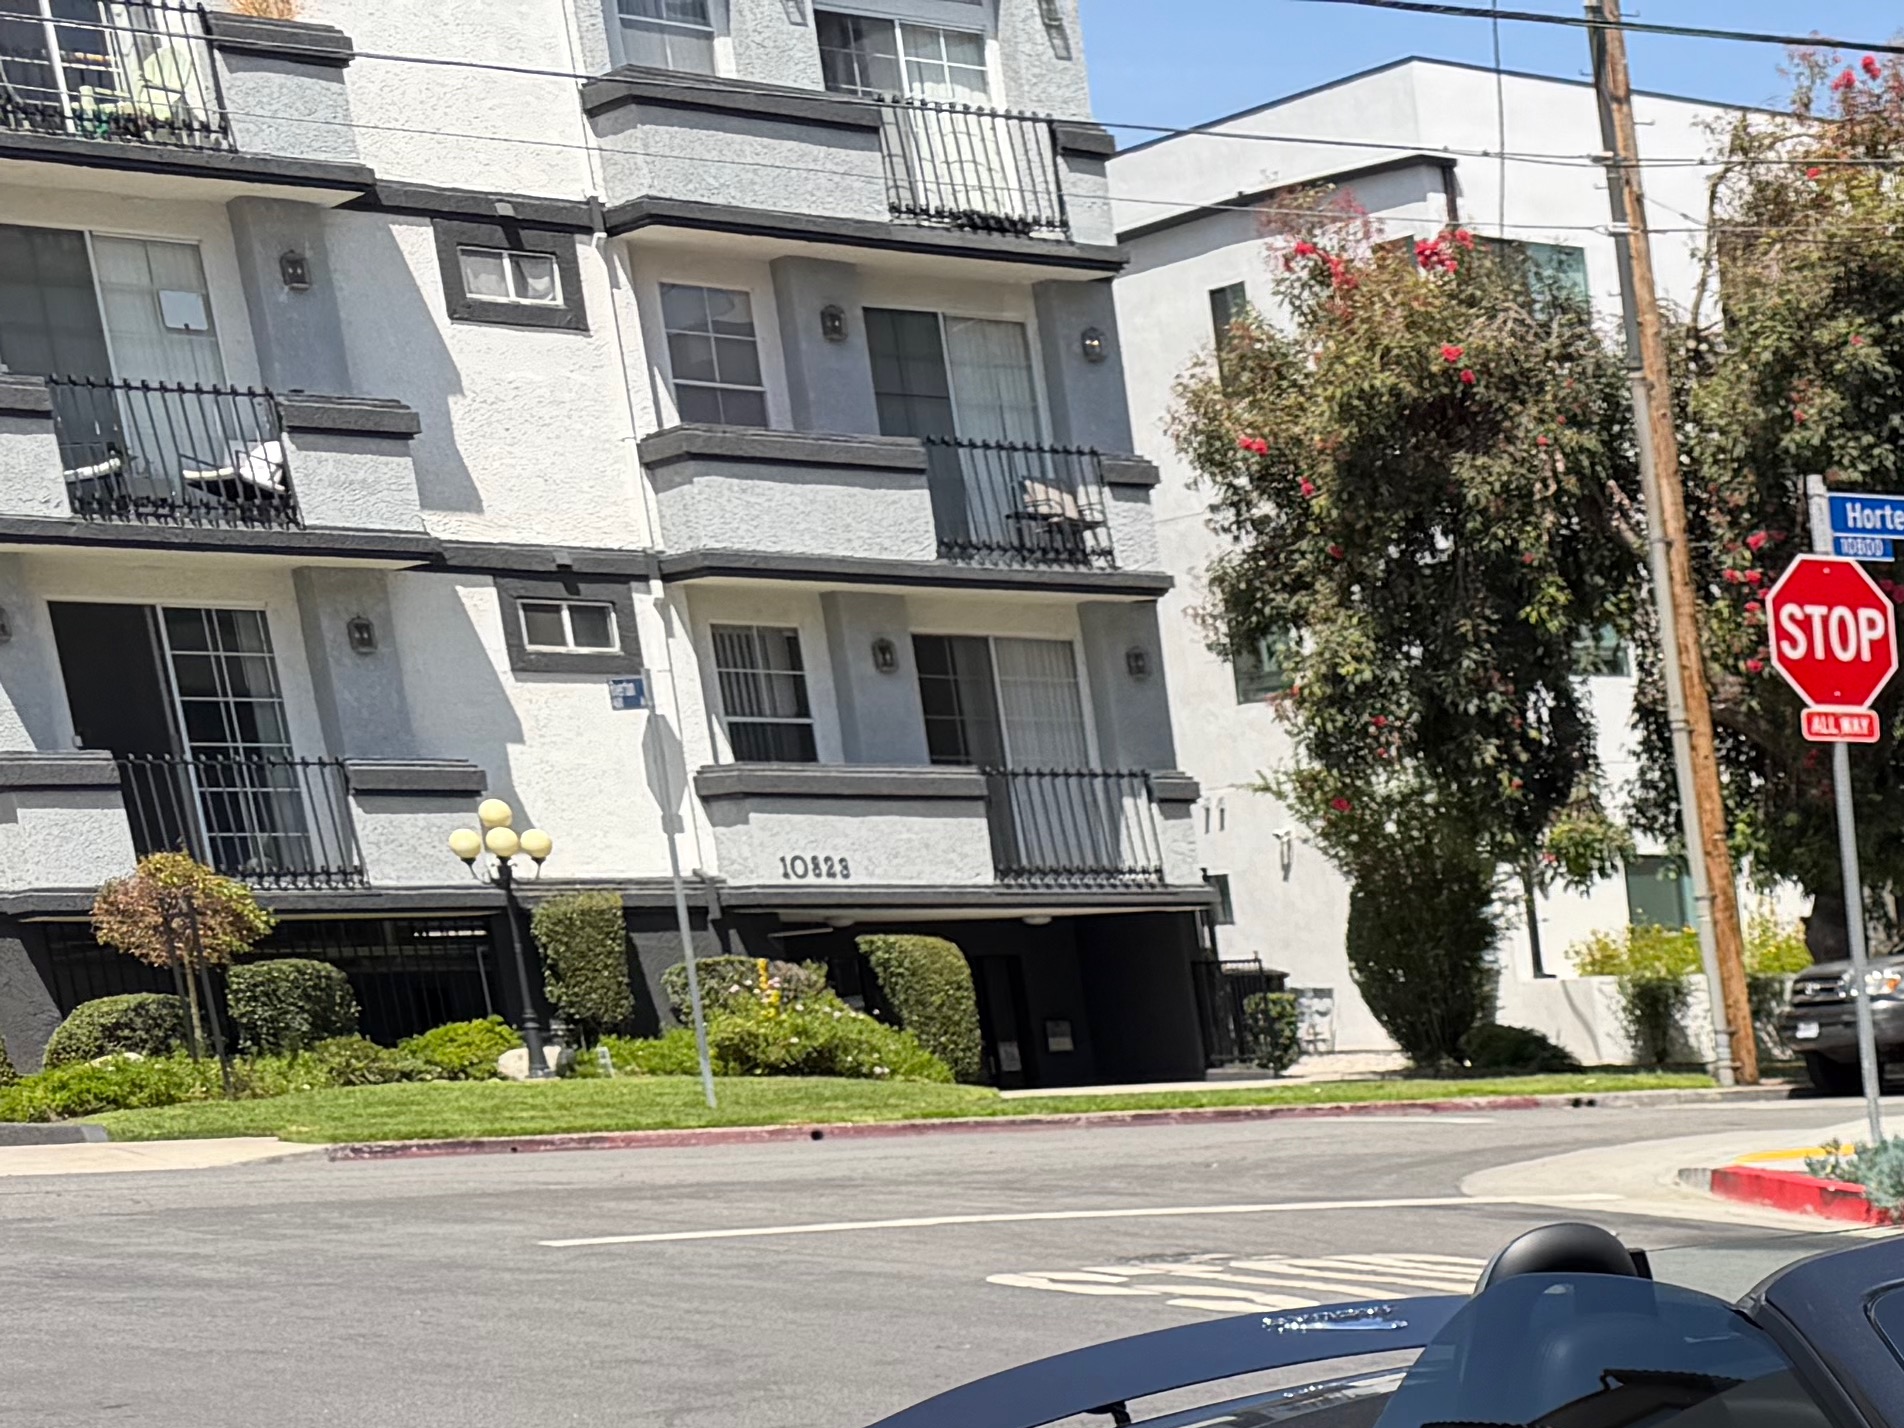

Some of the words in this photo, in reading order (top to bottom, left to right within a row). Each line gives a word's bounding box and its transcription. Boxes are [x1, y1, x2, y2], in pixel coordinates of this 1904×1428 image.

[1779, 602, 1885, 662] STOP
[1811, 714, 1839, 734] ALL
[1839, 716, 1870, 735] WAY
